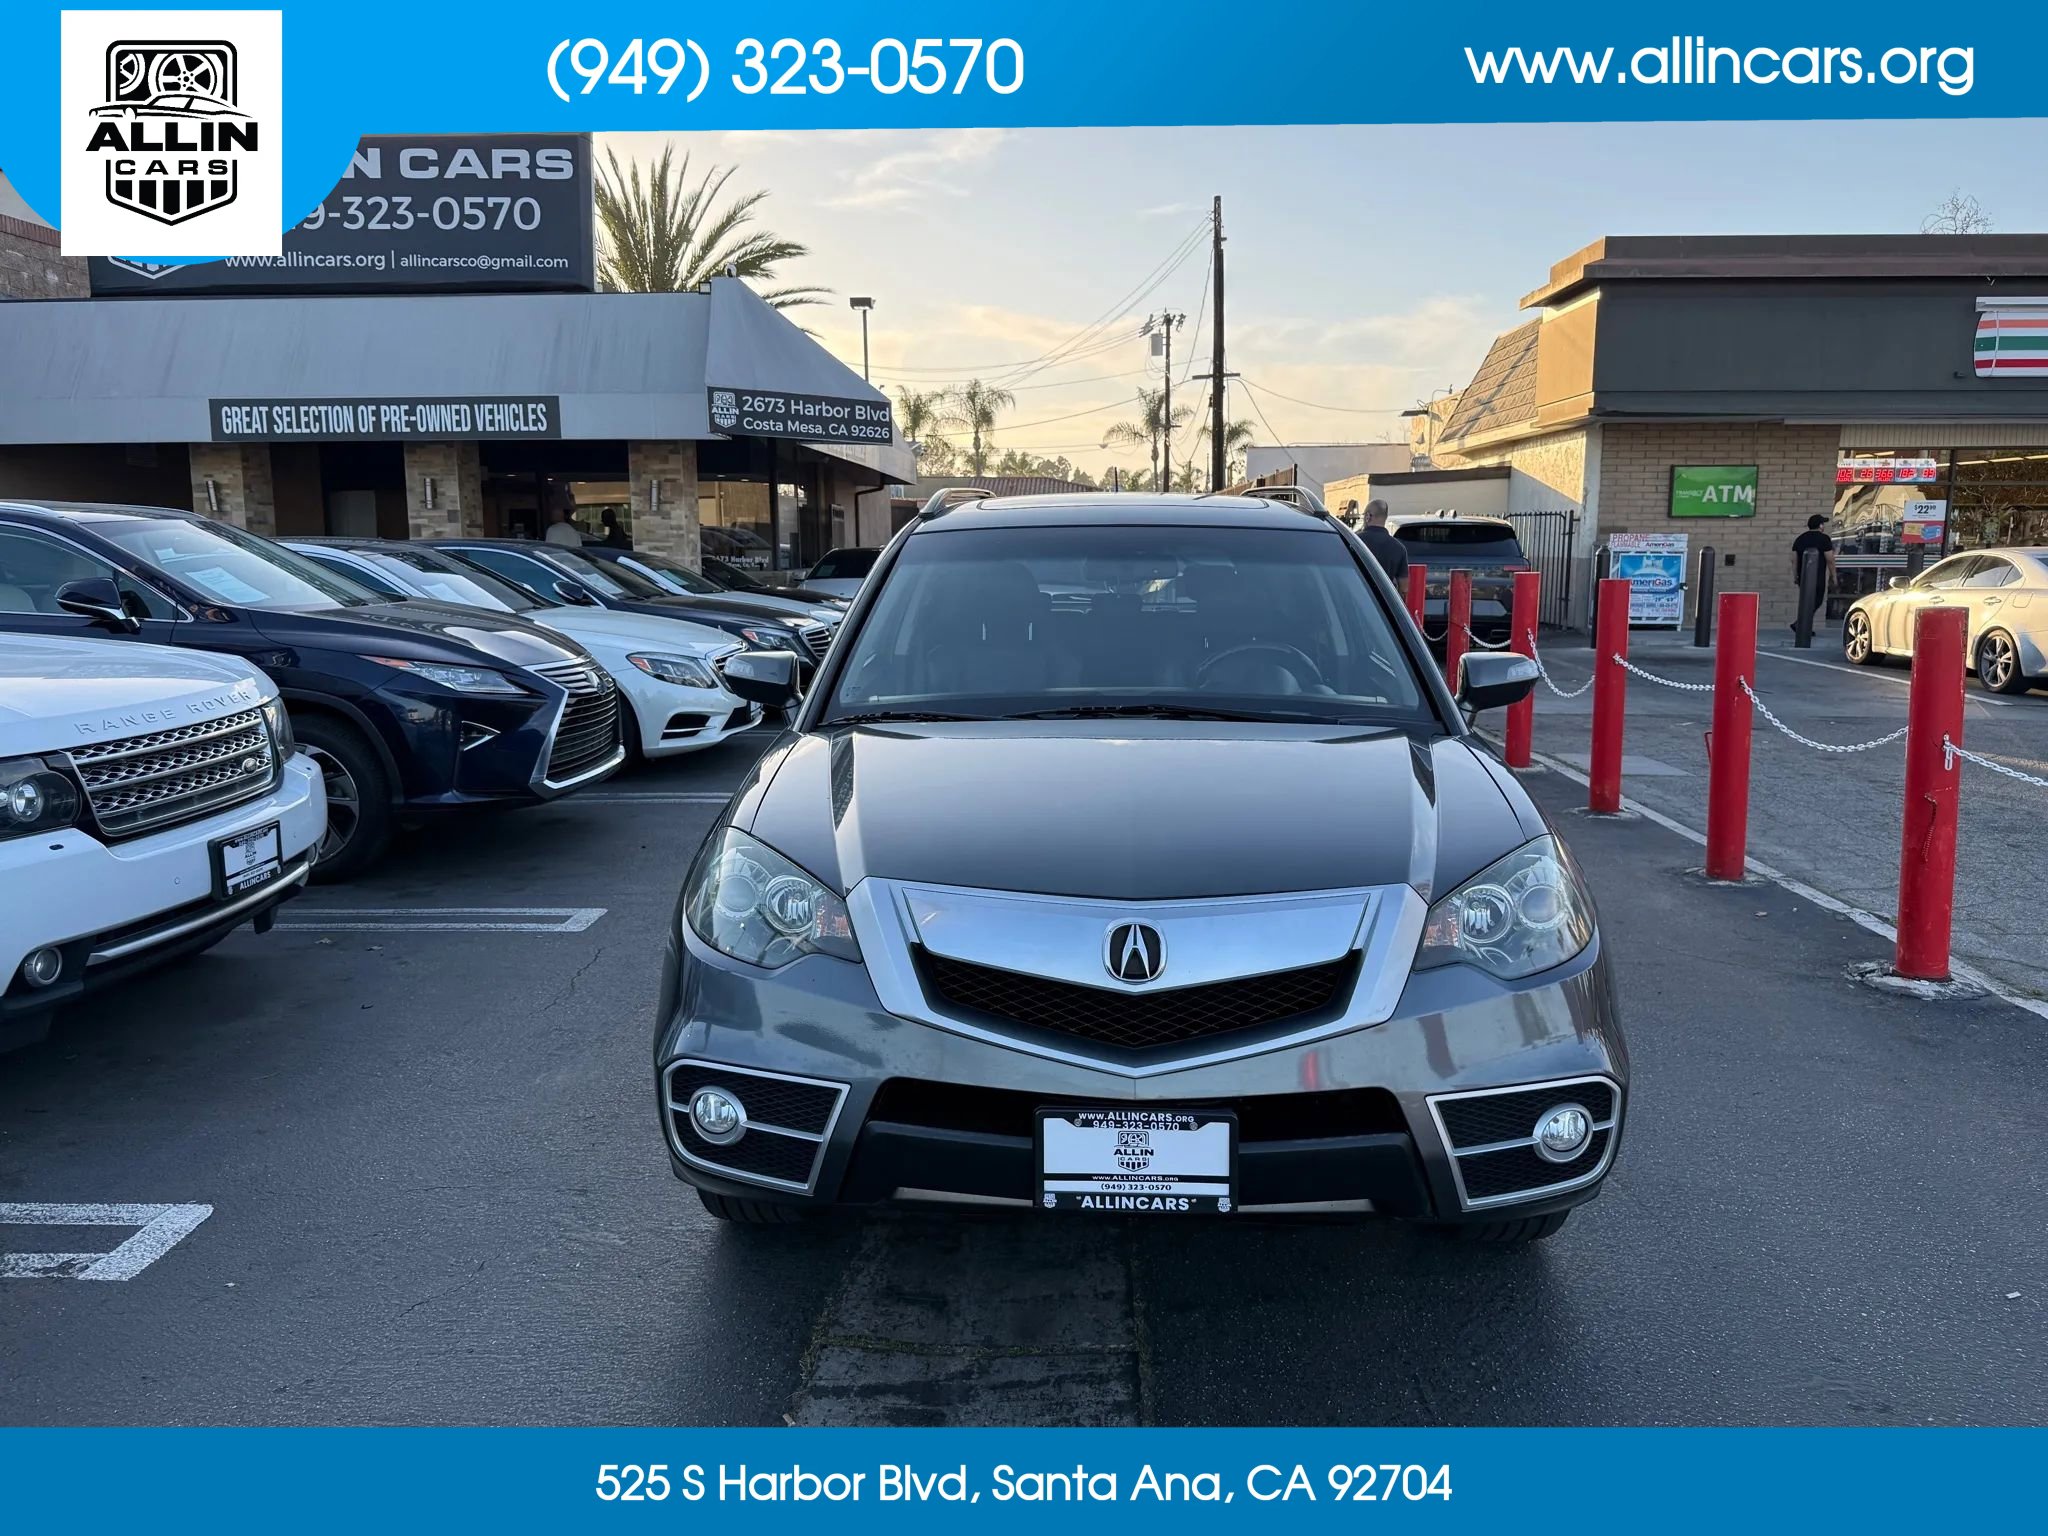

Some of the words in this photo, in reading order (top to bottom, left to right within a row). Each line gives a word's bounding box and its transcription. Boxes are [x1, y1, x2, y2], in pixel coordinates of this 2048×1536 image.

[400, 149, 574, 180] CARS
[292, 196, 541, 231] 9-323-0570
[400, 255, 569, 269] allincarsco@gmail.com
[221, 406, 269, 434] GREAT
[273, 405, 355, 434] SELECTION
[357, 405, 376, 433] OF
[381, 404, 471, 432] PRE-OWNED
[474, 403, 547, 432] VEHICLES
[711, 407, 740, 415] ALLIN
[742, 396, 786, 414] 2673
[791, 400, 851, 418] Harbor
[855, 405, 890, 422] Blvd
[743, 417, 784, 432] Costa
[787, 420, 826, 436] Mesa,
[828, 424, 848, 436] CA
[850, 425, 890, 439] 92626
[1702, 485, 1752, 503] ATM
[74, 709, 177, 735] RANGE
[186, 690, 252, 714] ROVER
[240, 871, 271, 890] ALLINCARS
[1093, 1121, 1180, 1131] 949-323-0570
[1113, 1149, 1155, 1157] ALLIN
[1101, 1183, 1126, 1191] (949)
[1127, 1183, 1172, 1191] 323-0570
